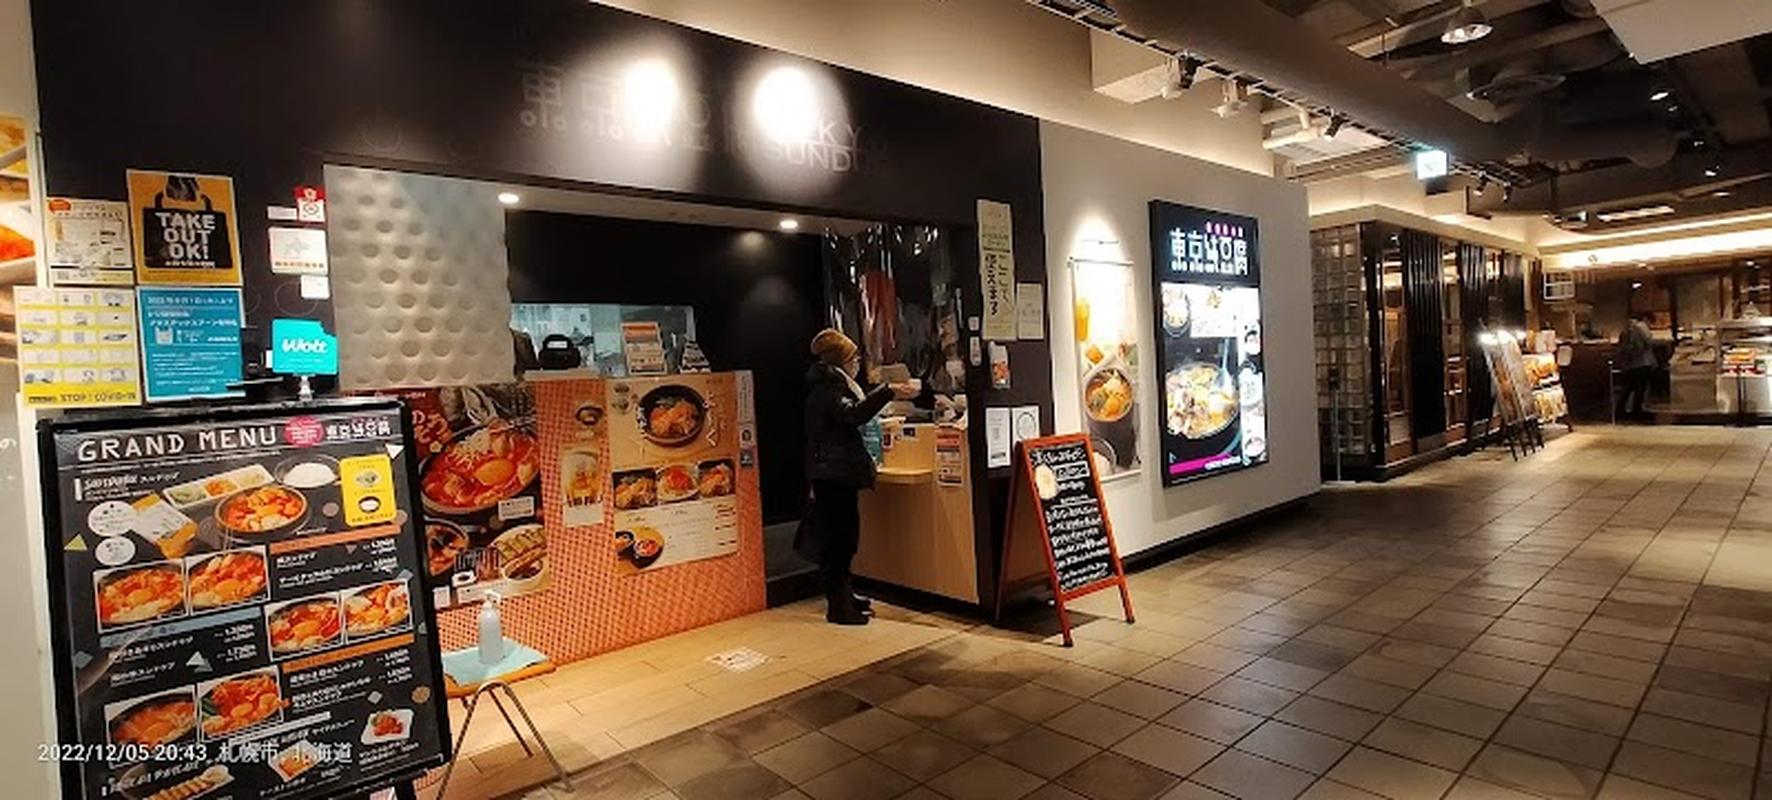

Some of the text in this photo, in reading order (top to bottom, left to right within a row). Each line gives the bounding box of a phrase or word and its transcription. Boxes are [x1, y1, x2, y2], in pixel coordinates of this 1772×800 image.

[154, 211, 216, 230] TAKE
[163, 228, 212, 246] OUT
[169, 243, 209, 260] OK!
[282, 338, 328, 354] Wolt
[78, 433, 185, 461] GRAND
[199, 426, 277, 451] MENU
